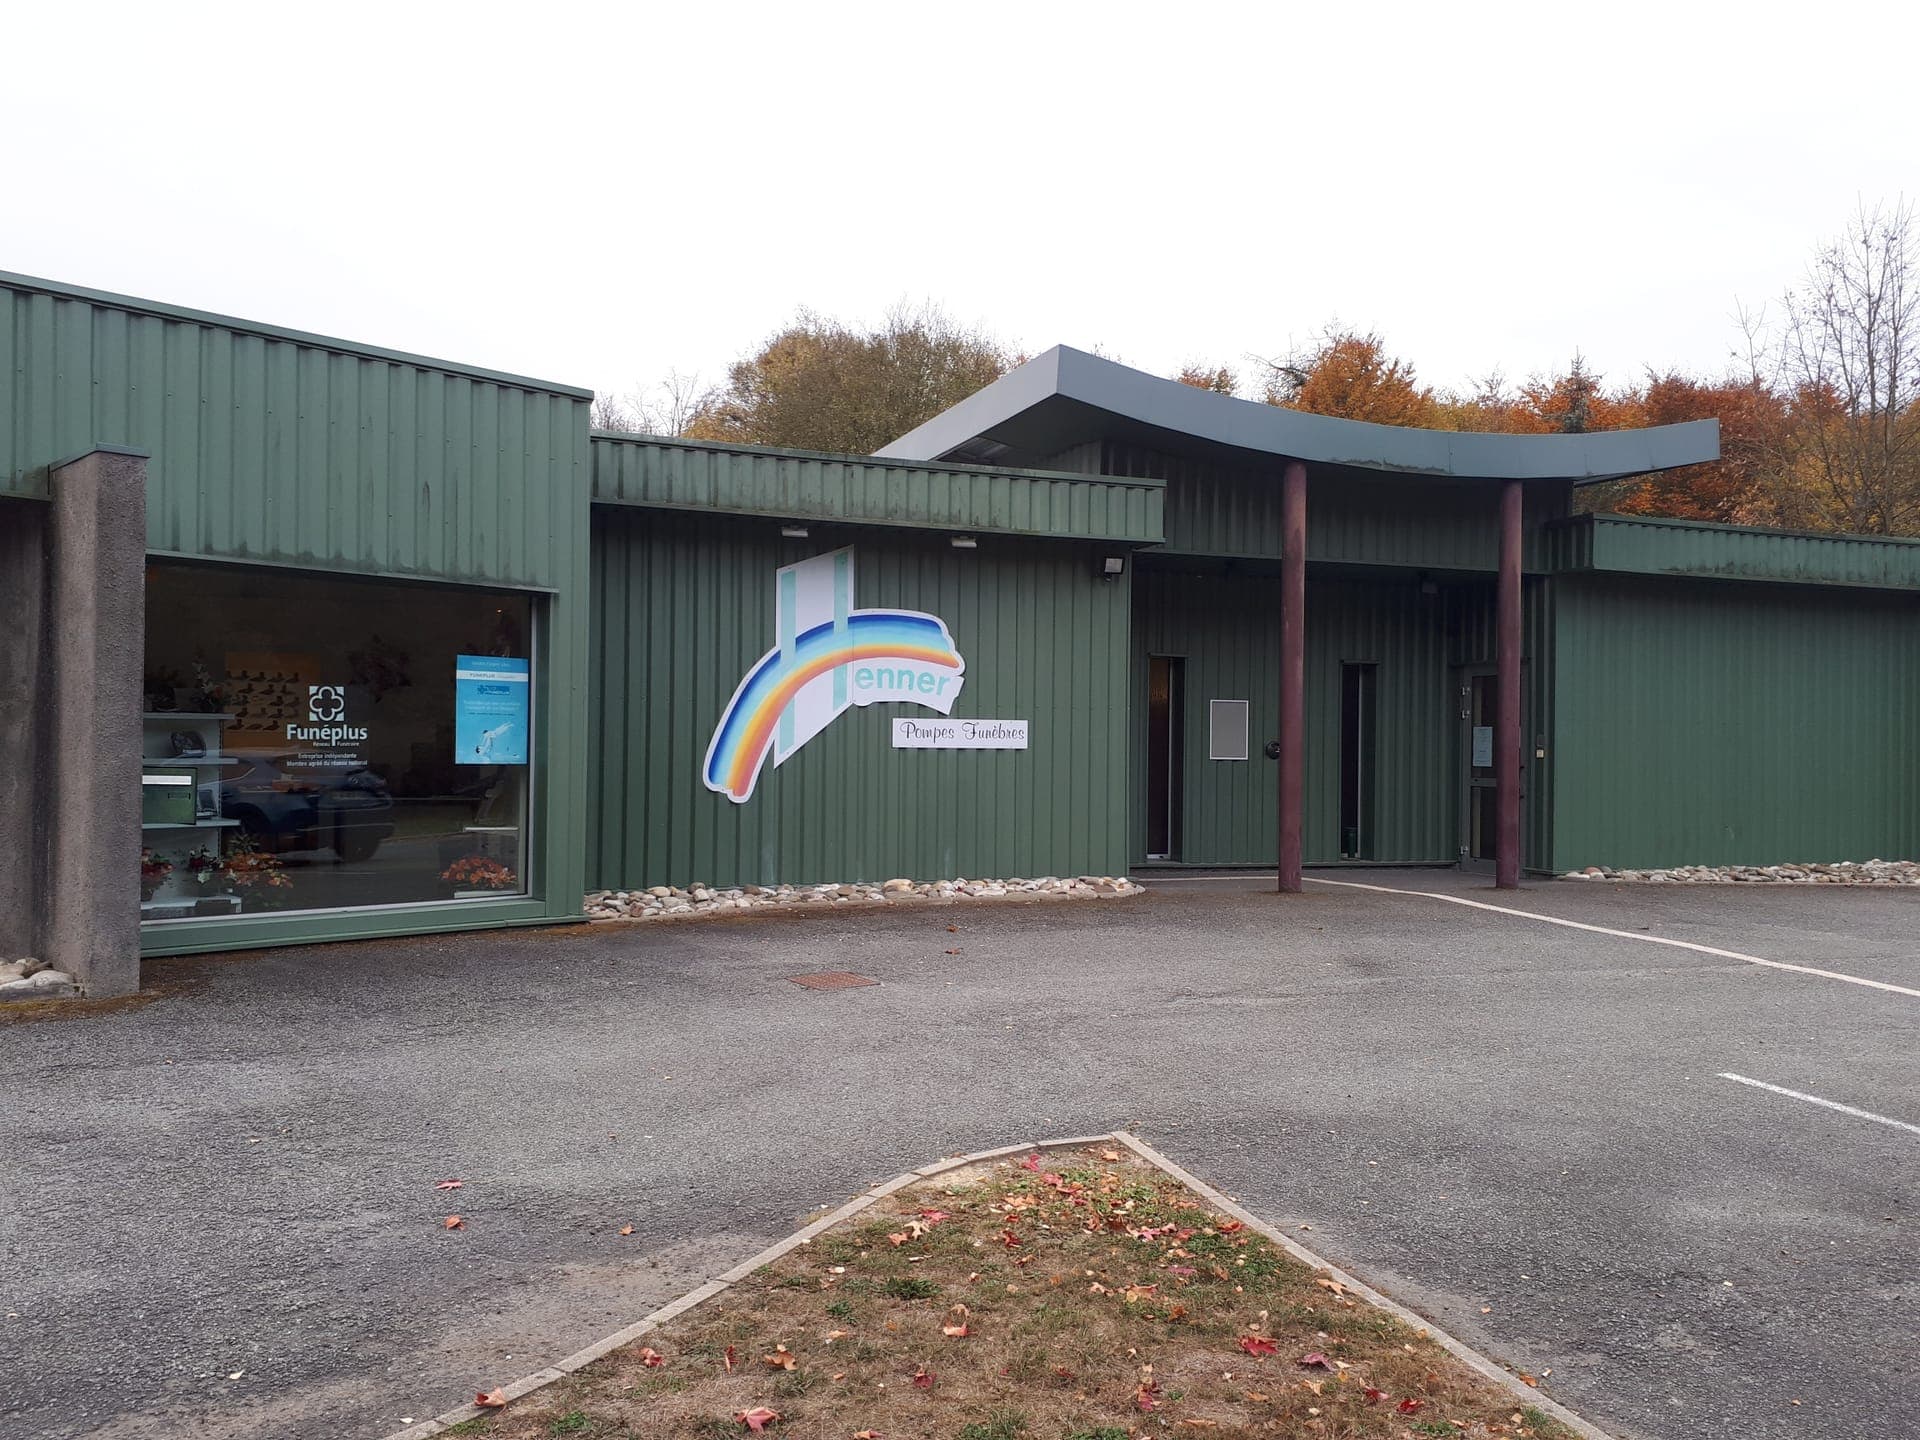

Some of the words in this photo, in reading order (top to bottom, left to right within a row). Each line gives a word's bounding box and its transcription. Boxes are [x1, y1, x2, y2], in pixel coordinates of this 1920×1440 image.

[286, 724, 368, 746] Funéplus
[900, 721, 954, 744] Pompes
[962, 721, 1024, 740] Funèbres
